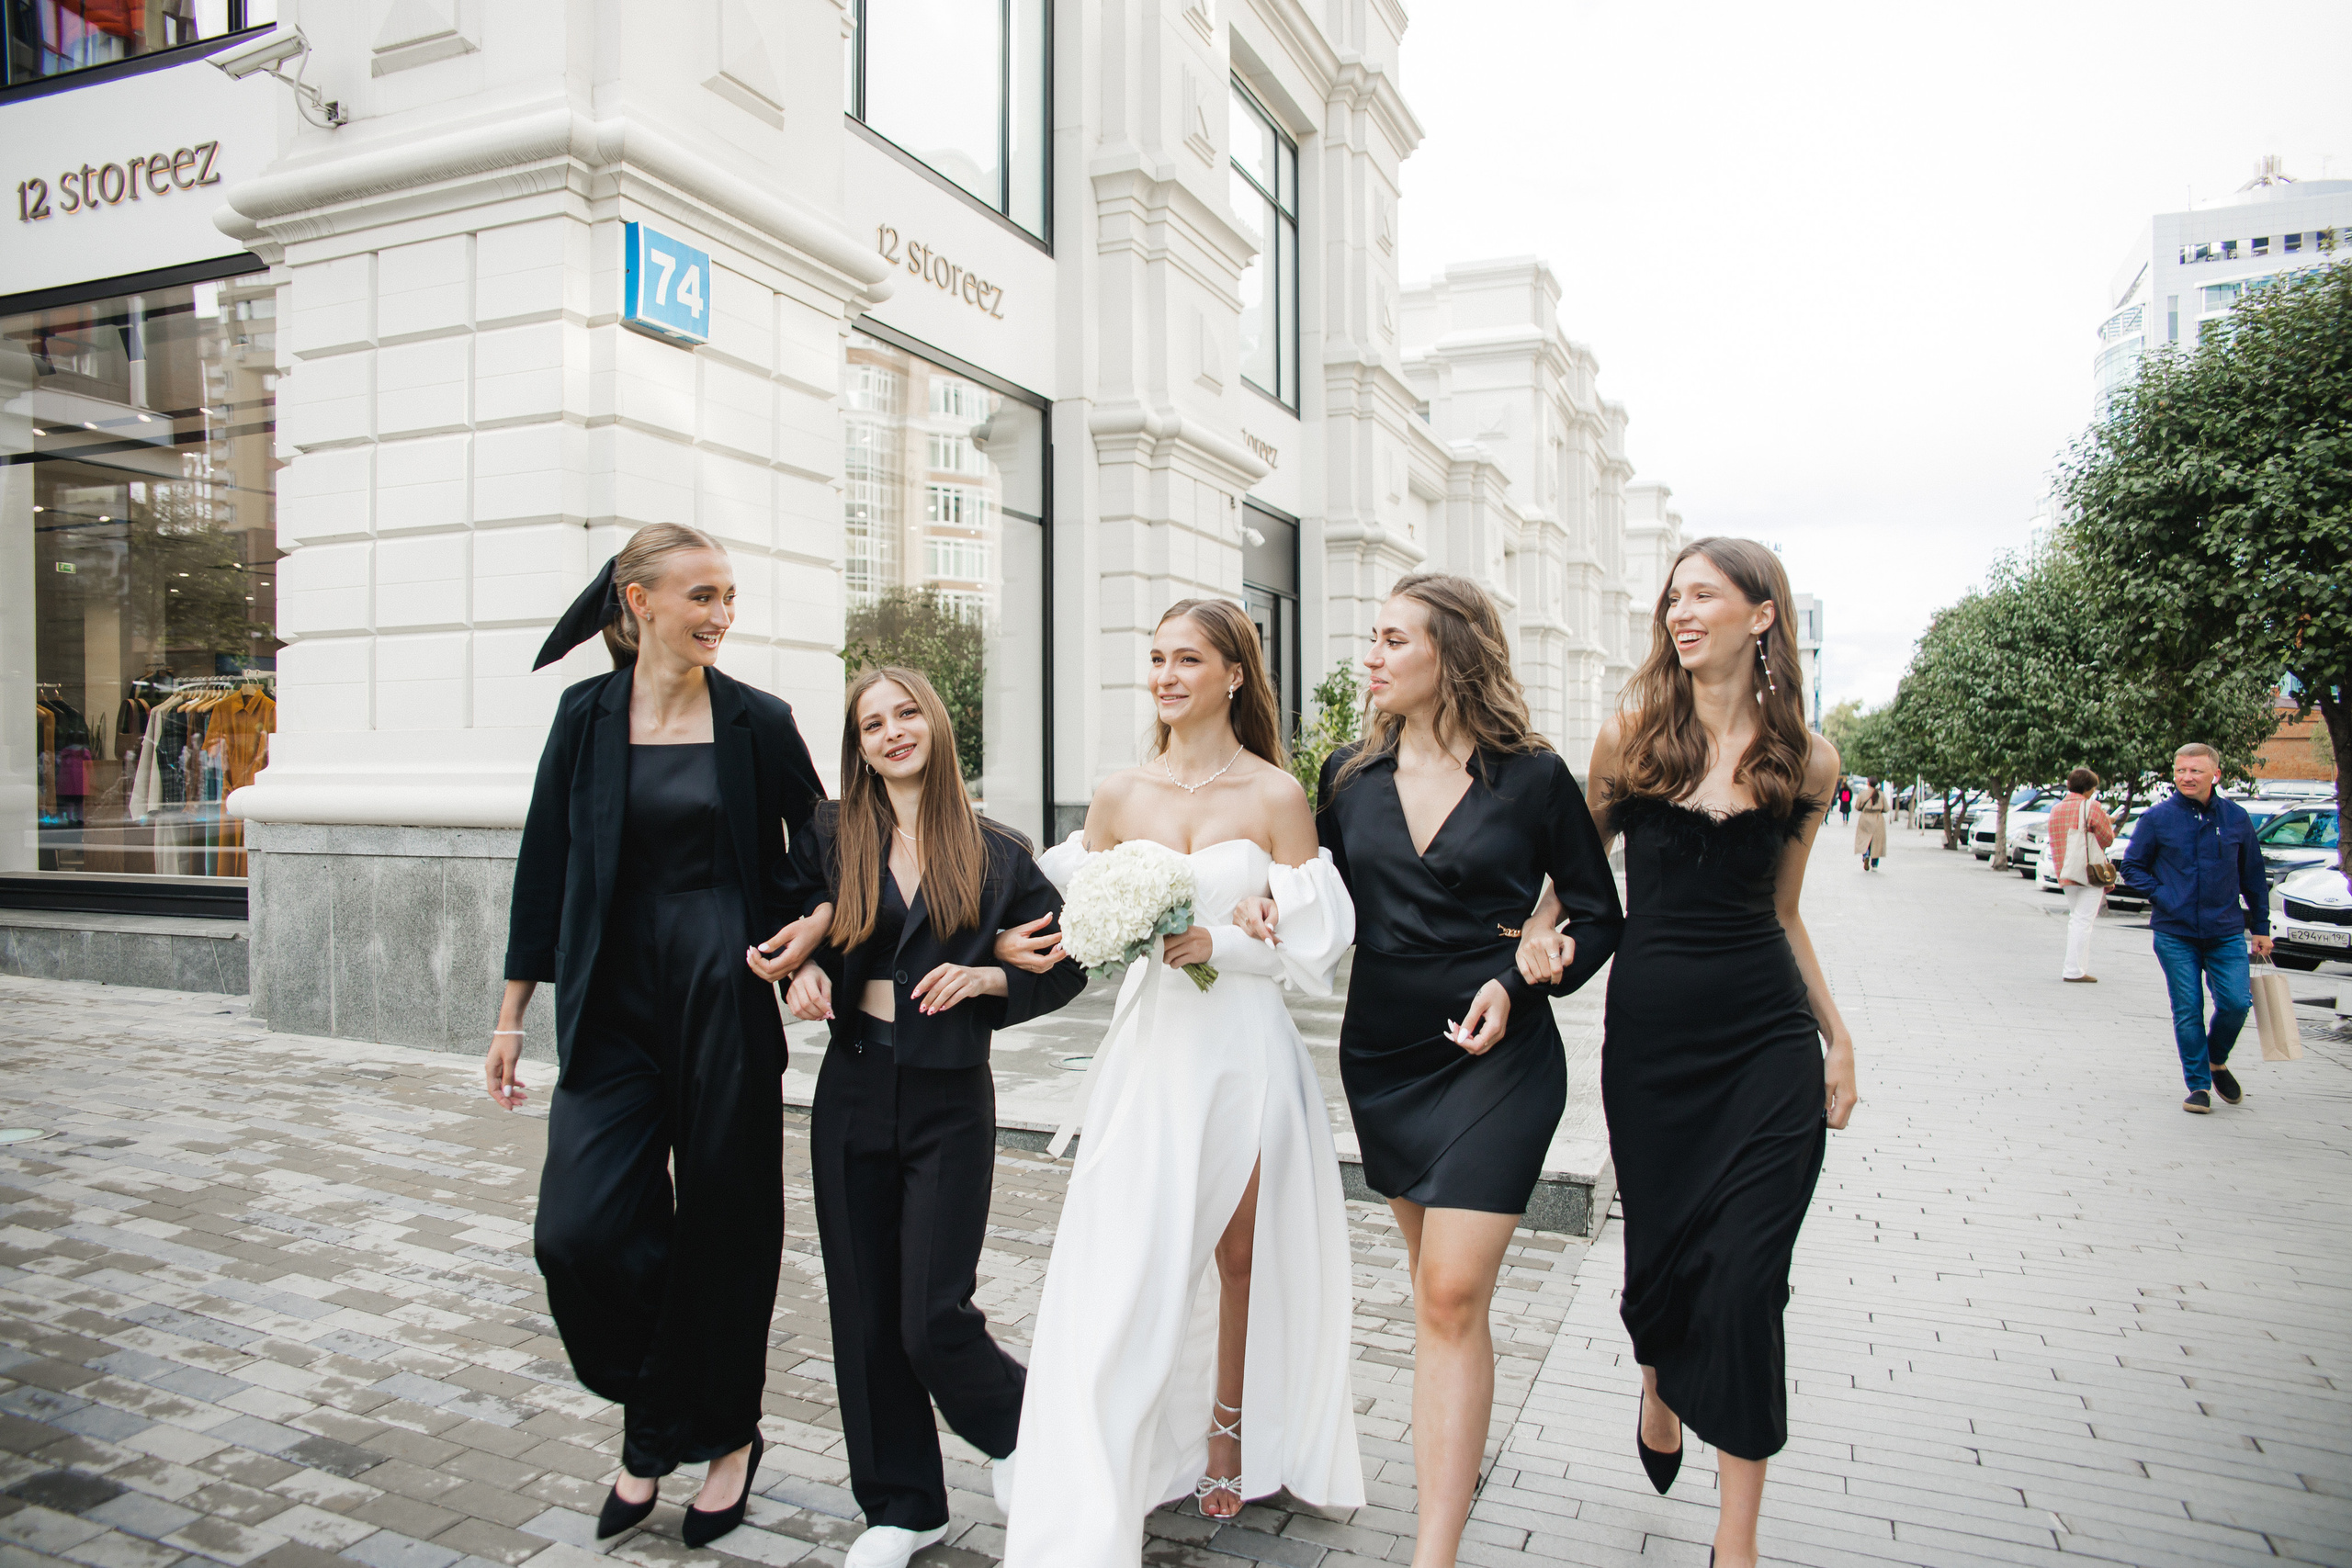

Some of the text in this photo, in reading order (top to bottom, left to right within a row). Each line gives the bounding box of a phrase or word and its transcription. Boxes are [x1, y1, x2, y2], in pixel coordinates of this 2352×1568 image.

[17, 141, 221, 222] 12 storeez
[650, 247, 704, 320] 74
[877, 223, 1004, 320] 12 storeez
